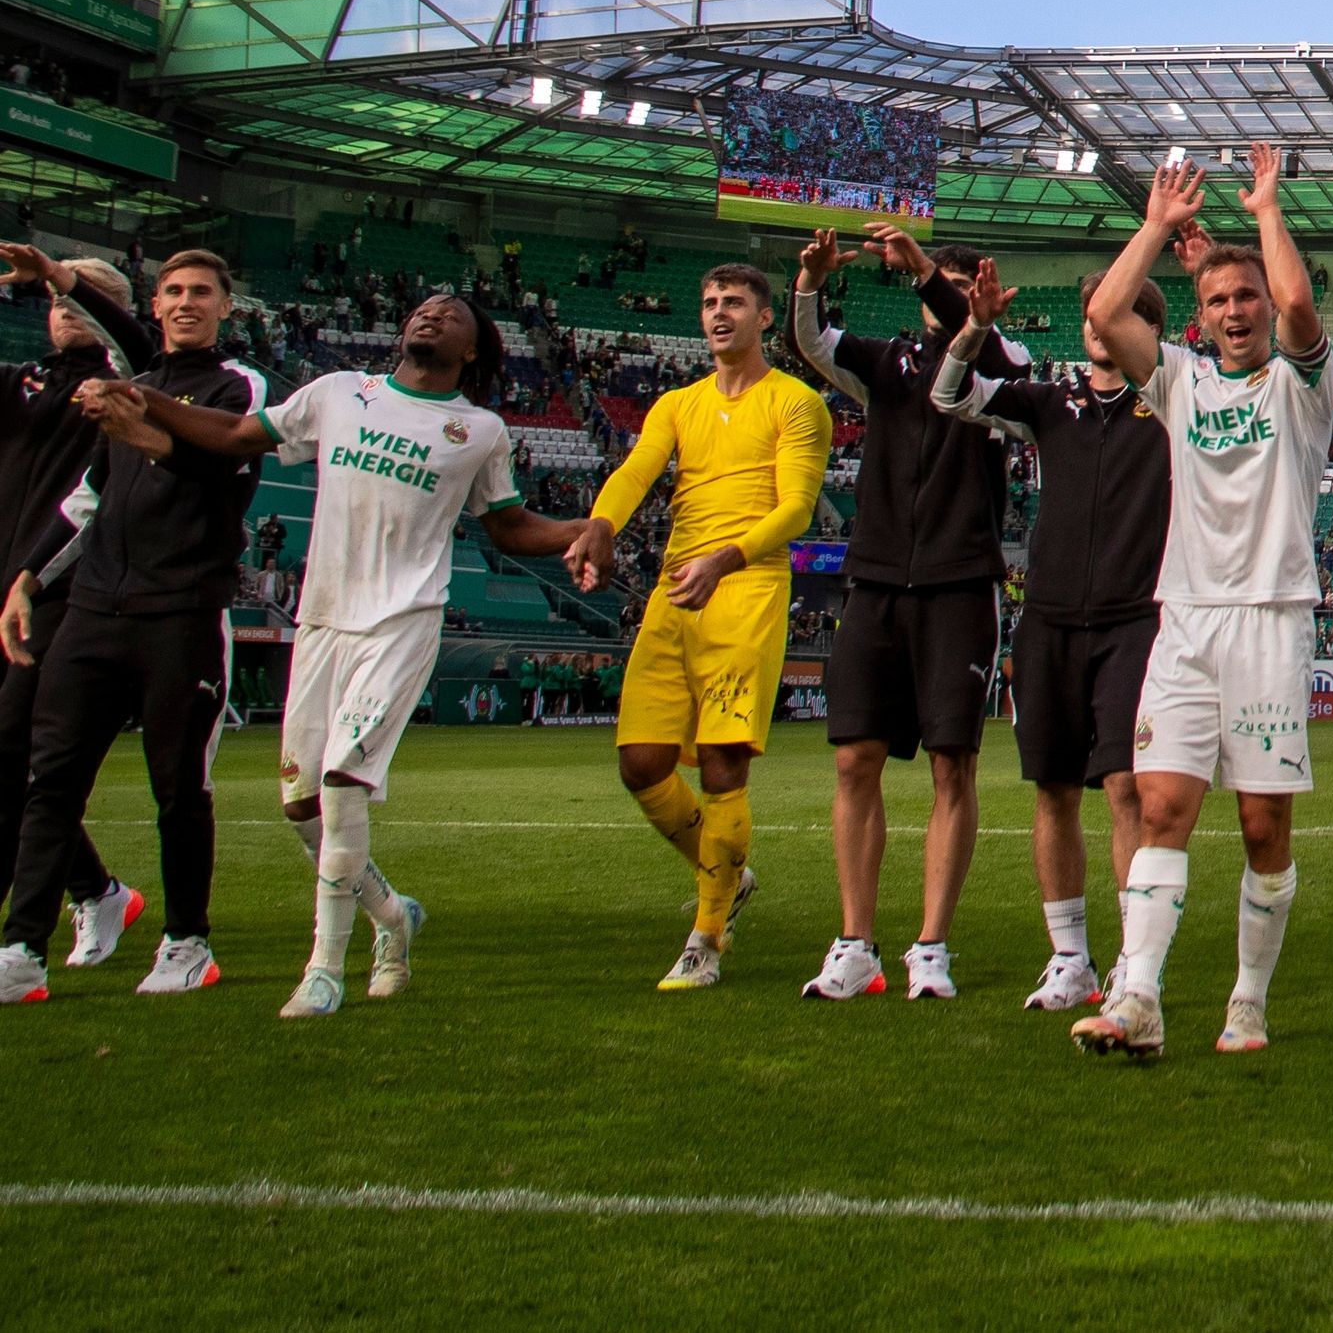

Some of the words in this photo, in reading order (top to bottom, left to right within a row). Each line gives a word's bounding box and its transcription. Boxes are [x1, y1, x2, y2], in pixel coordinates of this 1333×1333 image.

[1195, 402, 1254, 431] WIEN
[359, 426, 432, 463] WIEN
[1187, 418, 1275, 451] NERGIE
[329, 447, 441, 493] ENERGIE
[1240, 701, 1291, 717] WIENER
[1231, 719, 1300, 734] ZUCKER
